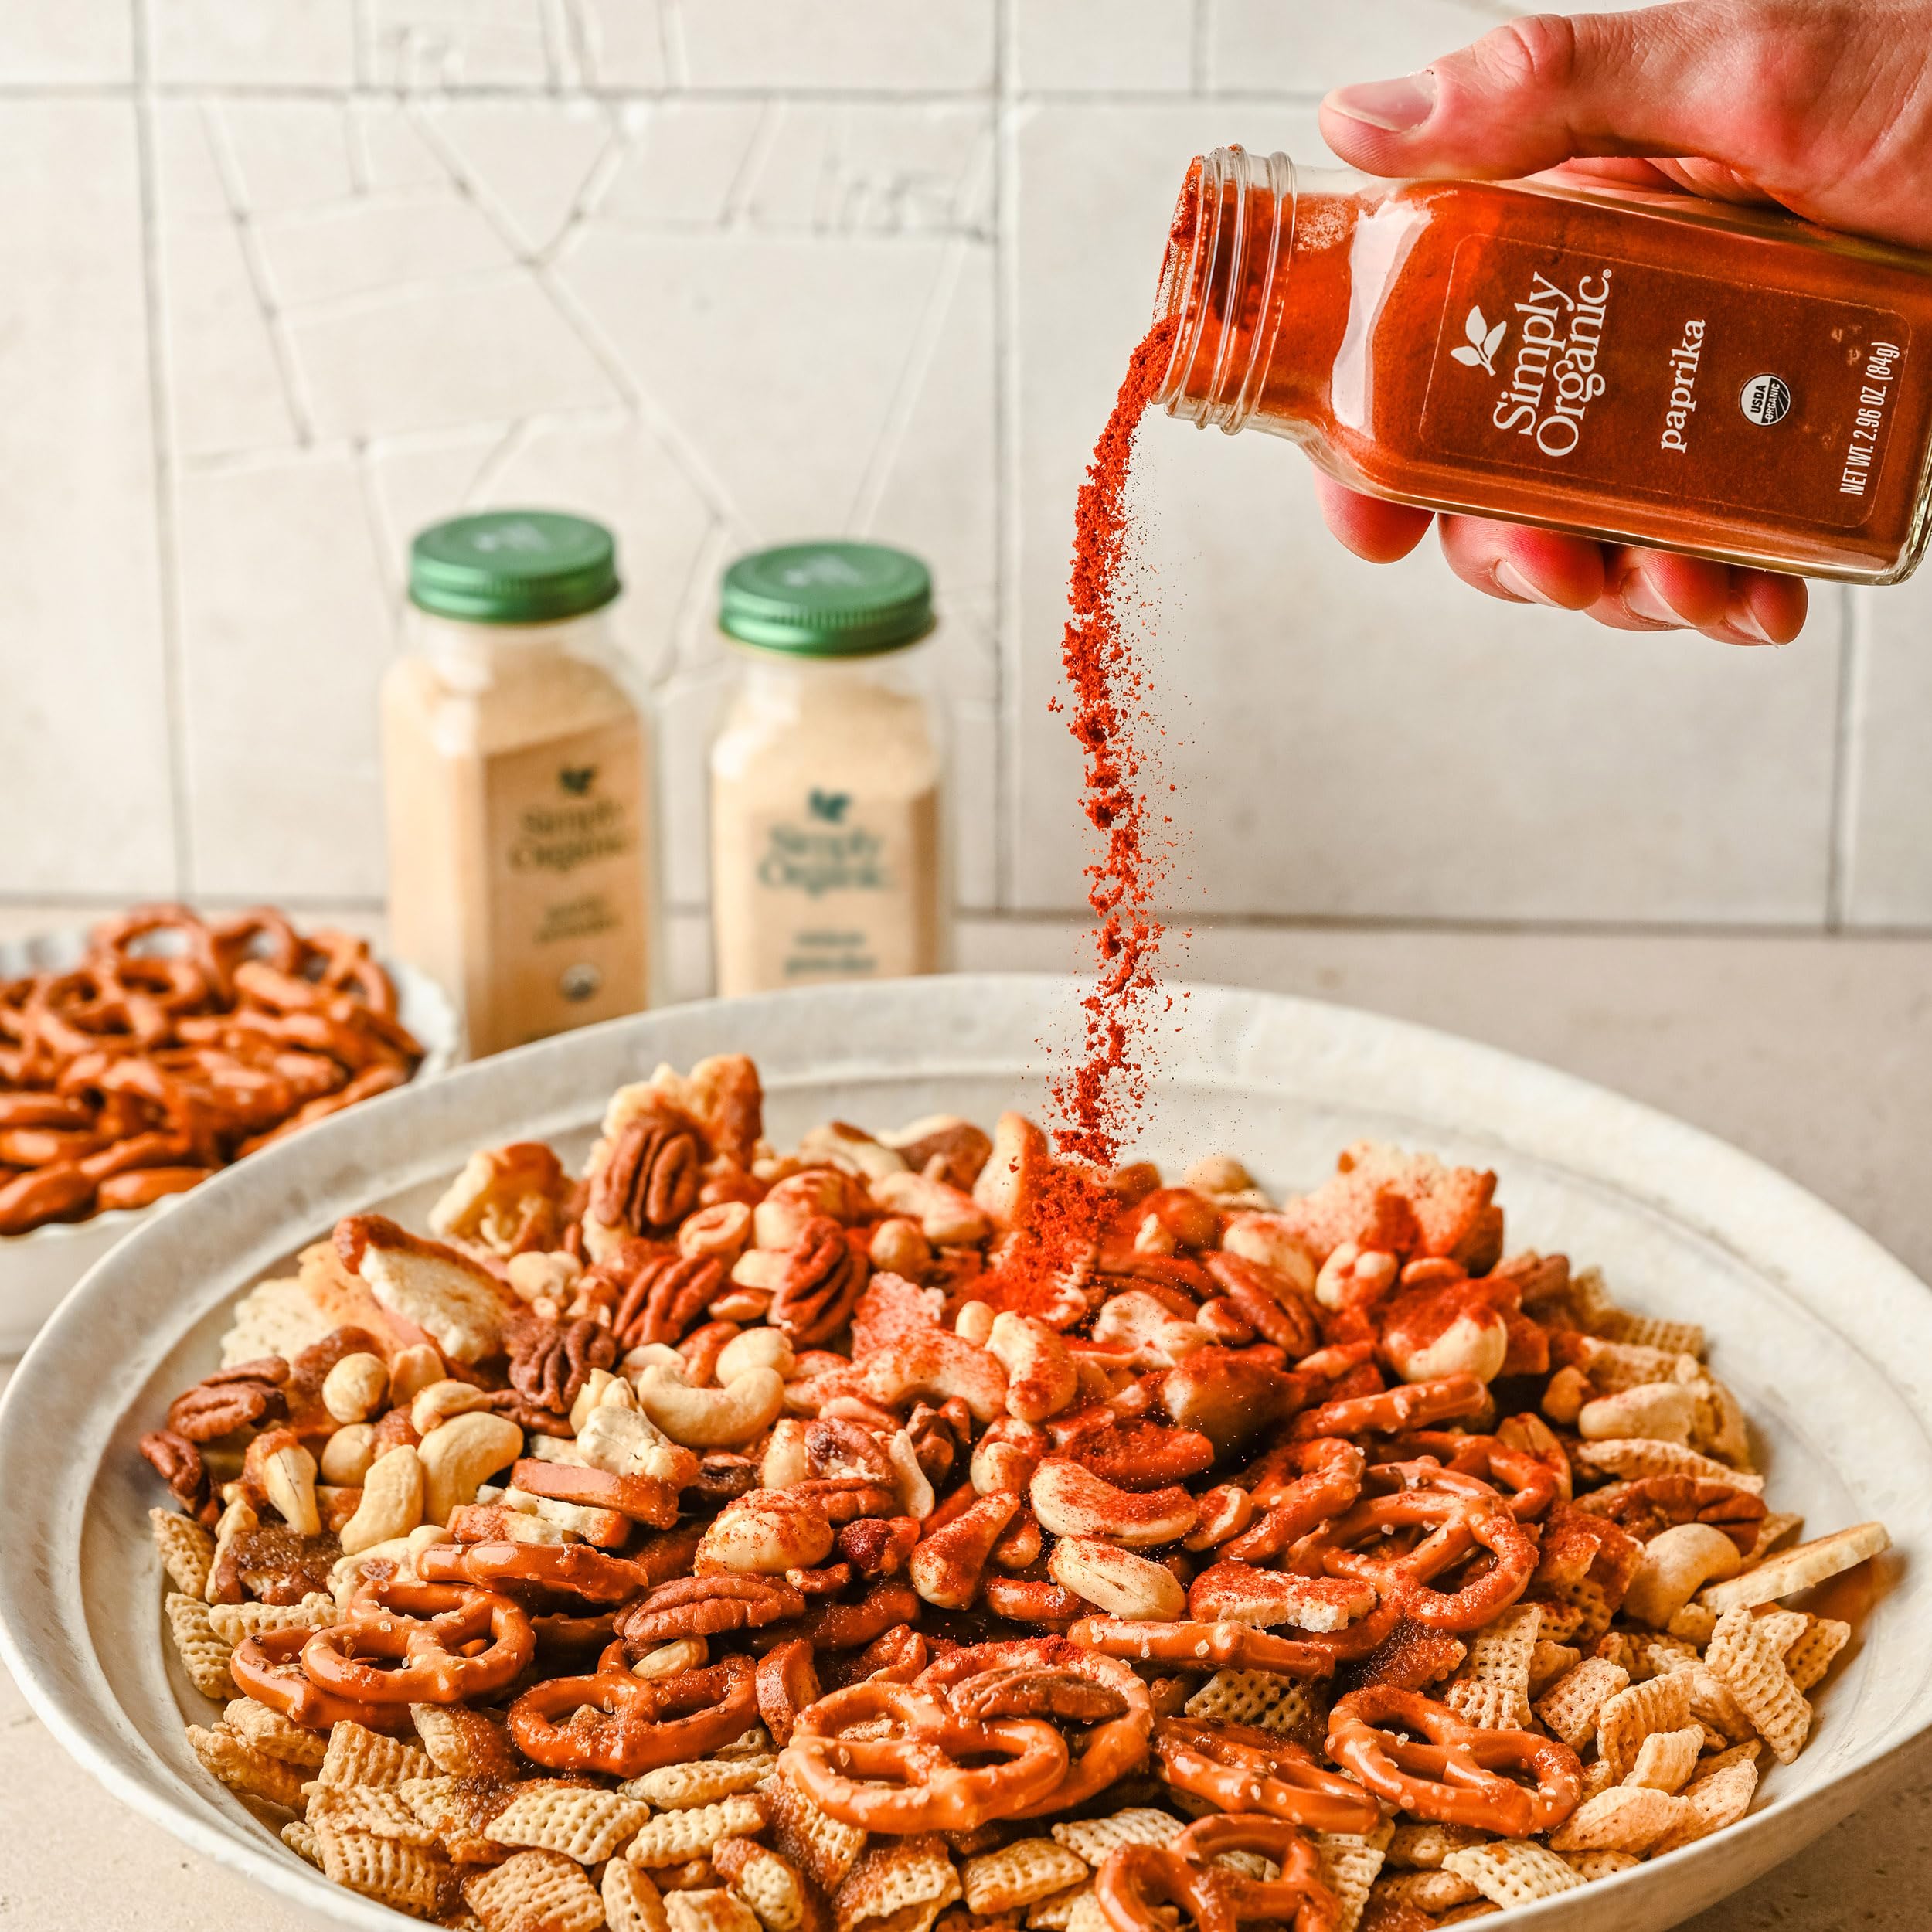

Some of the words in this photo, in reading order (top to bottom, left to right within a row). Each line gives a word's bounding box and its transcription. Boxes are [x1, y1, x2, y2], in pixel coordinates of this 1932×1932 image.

[1492, 271, 1574, 436] Simply
[1866, 342, 1900, 381] (84g)
[1661, 318, 1706, 454] paprika
[1751, 385, 1766, 413] USDA
[1765, 383, 1781, 420] ORGANIC
[1860, 386, 1886, 406] OZ.
[1853, 408, 1881, 441] 2.96
[1846, 444, 1874, 467] WT.
[1840, 468, 1867, 495] NET
